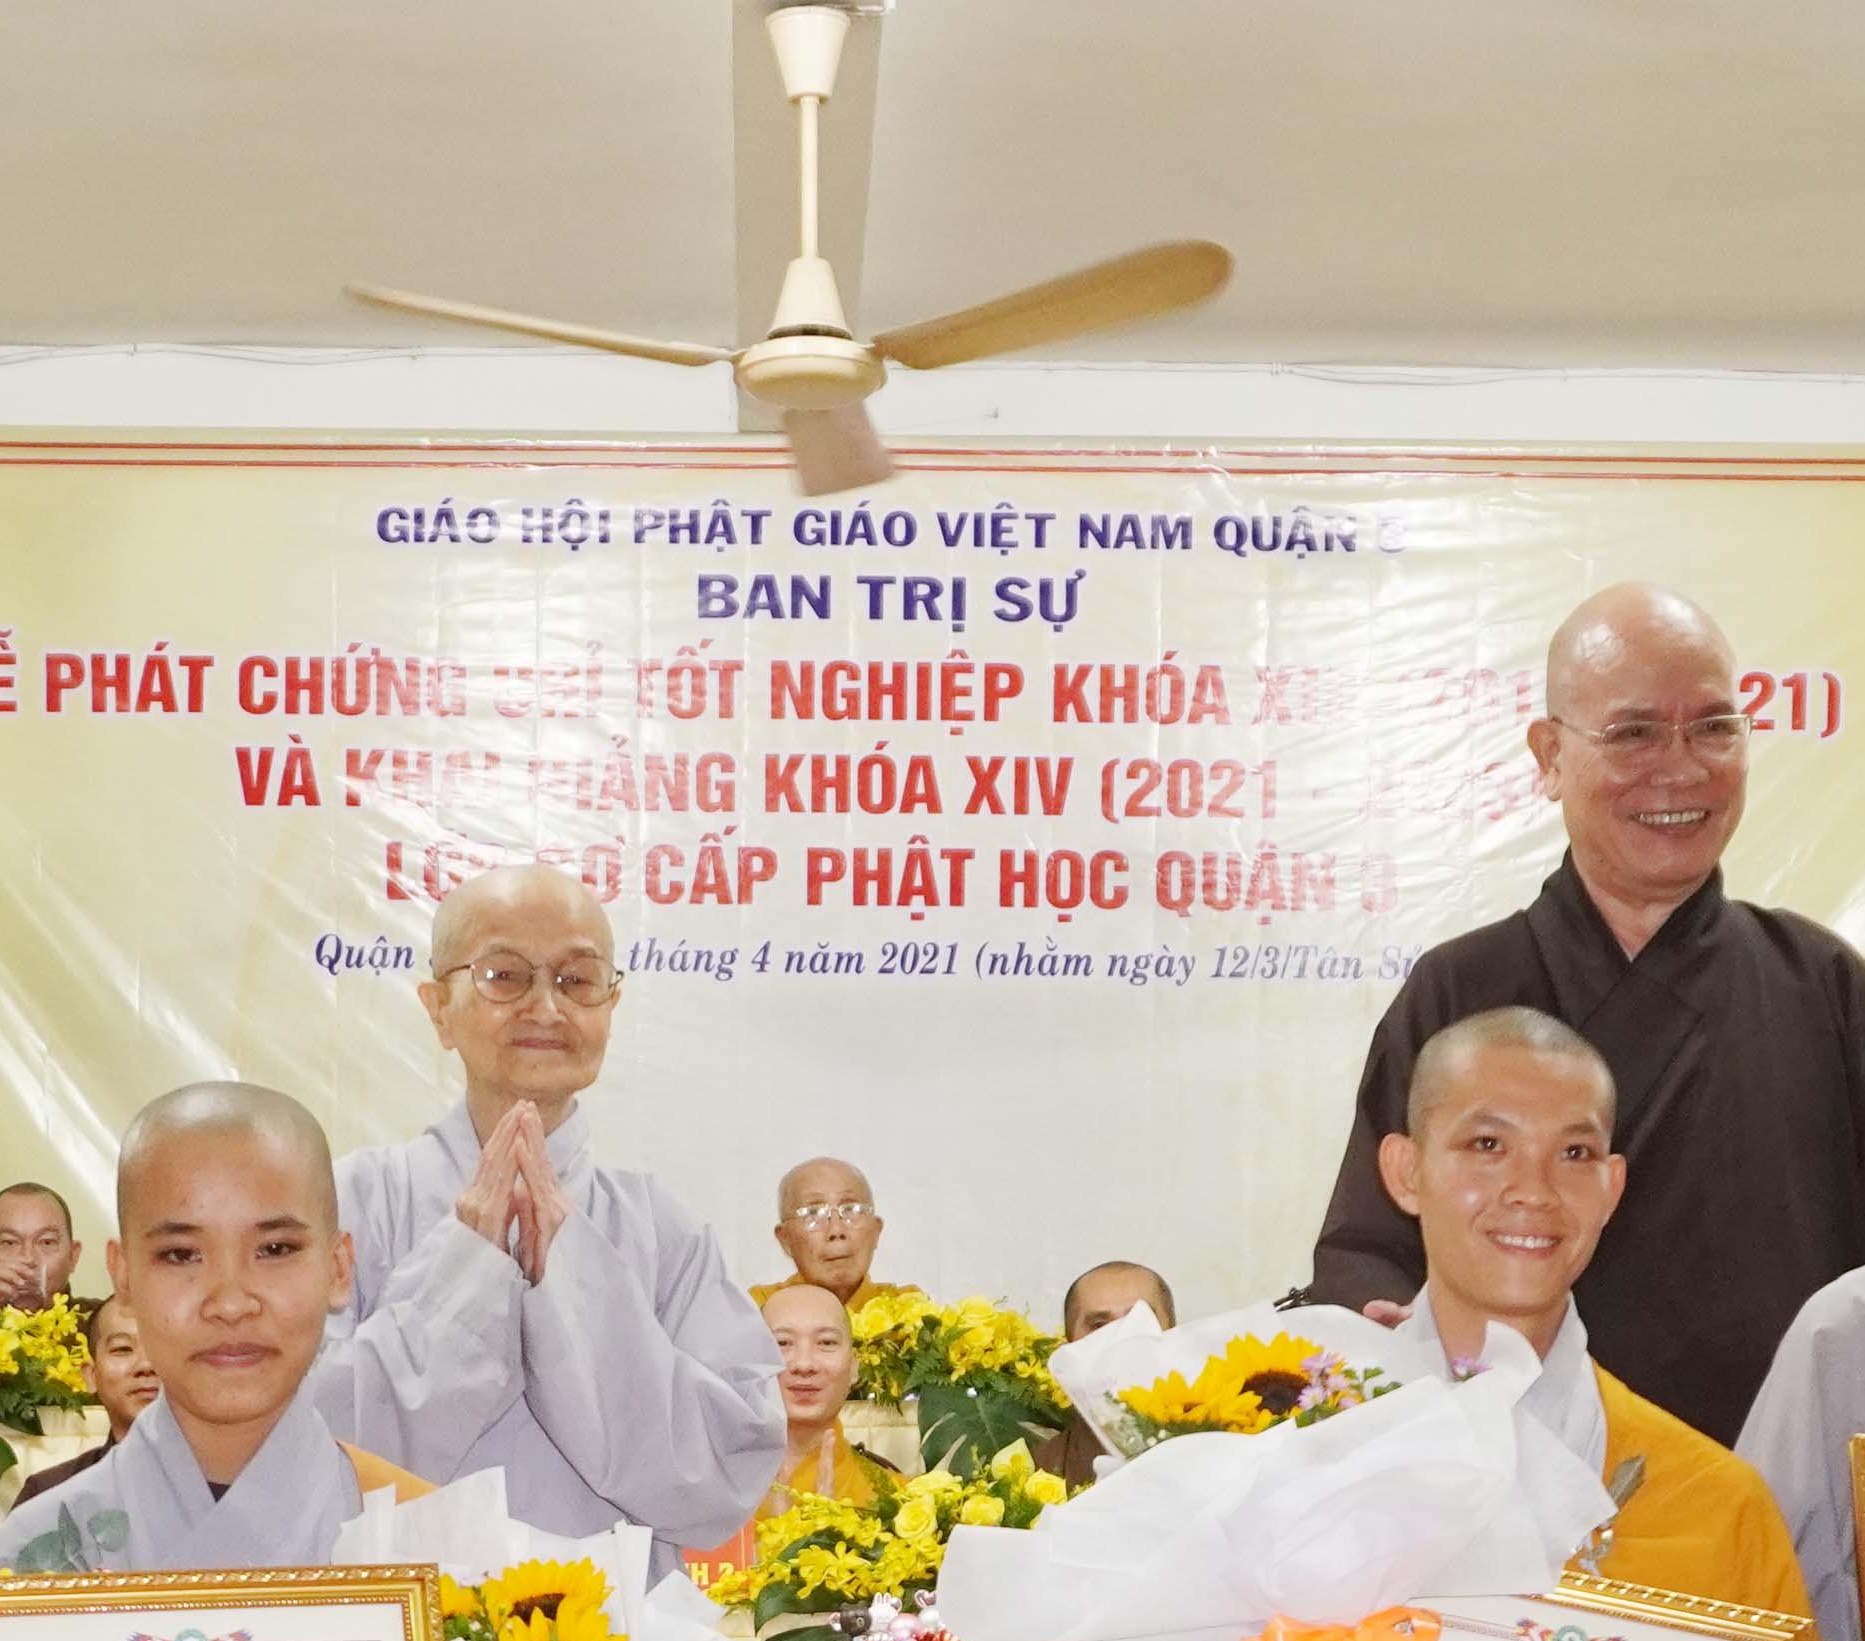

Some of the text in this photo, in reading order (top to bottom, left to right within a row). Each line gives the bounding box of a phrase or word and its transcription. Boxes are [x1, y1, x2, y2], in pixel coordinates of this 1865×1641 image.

[375, 497, 501, 544] GIÁO
[521, 498, 611, 552] HỘI
[634, 498, 773, 553] PHẬT
[793, 501, 918, 548] GIÁO
[938, 502, 1057, 556] VIỆT
[1078, 512, 1194, 552] NAM
[1215, 506, 1358, 559] QUẬN
[697, 569, 1087, 633] BAN TRỊ SỰ
[45, 640, 215, 714] PHÁT
[238, 642, 468, 717] CHỨNG
[633, 638, 744, 721] TỐT
[770, 649, 1026, 736] NGHIỆP
[1051, 650, 1231, 726] KHÓA
[1738, 671, 1842, 738] 21)
[235, 734, 322, 807] VÀ
[764, 740, 944, 816] KHÓA
[963, 756, 1075, 817] XIV
[1101, 758, 1278, 825] (2021
[644, 825, 778, 906] CẤP
[806, 834, 976, 921] PHẬT
[999, 848, 1130, 924] HỌC
[1155, 839, 1337, 925] QUẬN
[315, 933, 415, 976] Quận
[628, 940, 740, 975] tháng
[751, 940, 772, 974] 4
[784, 943, 866, 975] năm
[878, 942, 960, 976] 2021
[975, 936, 1094, 980] (nhằm
[1107, 945, 1197, 986] ngày
[1209, 944, 1365, 981] 12/3/Tân
